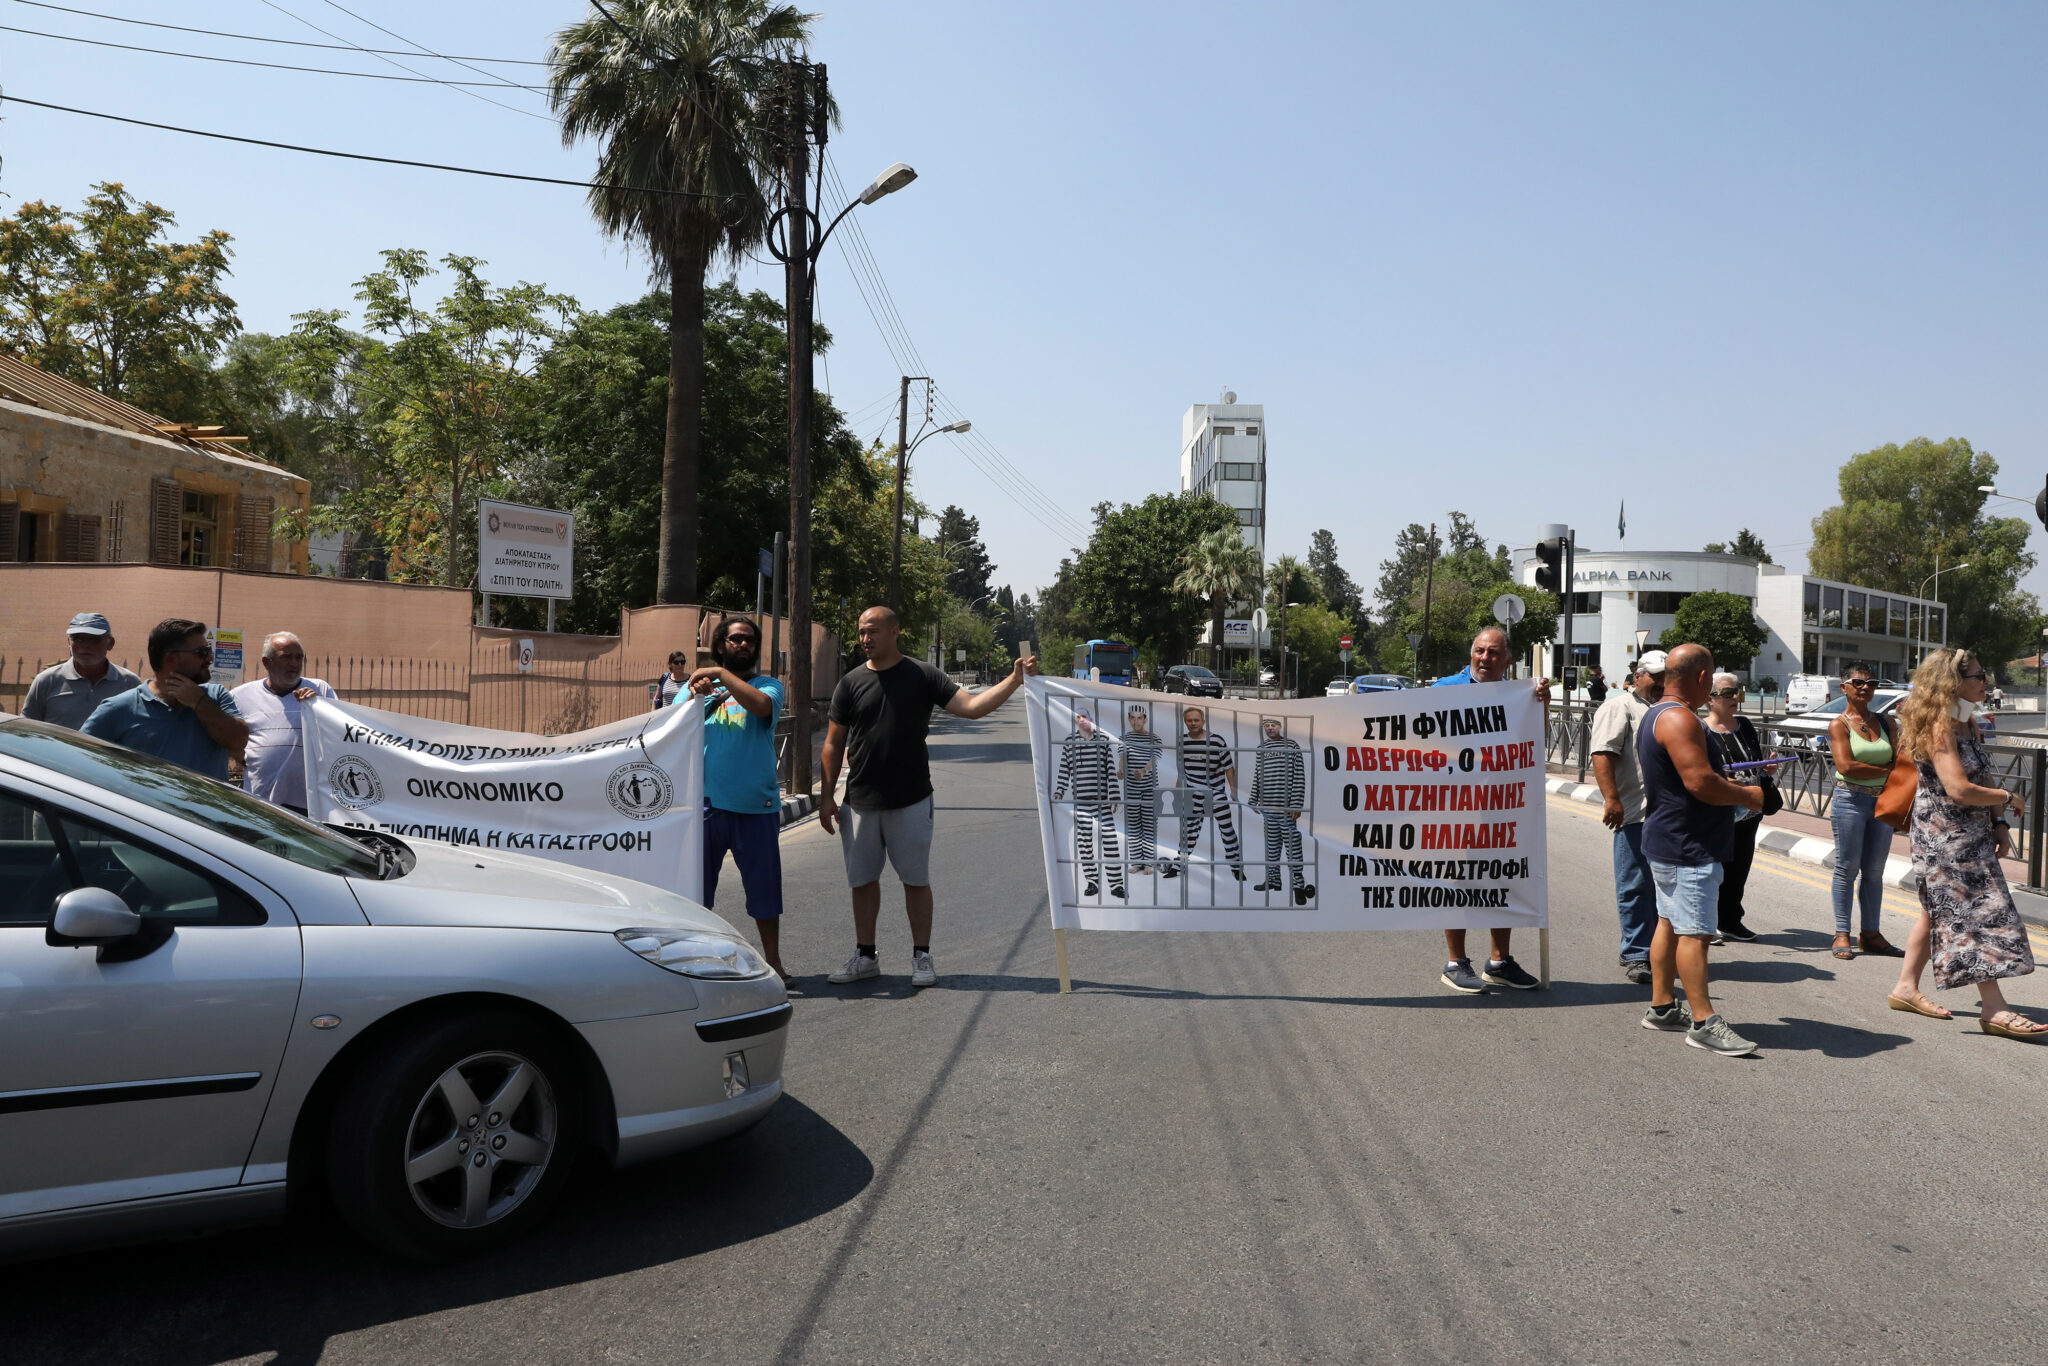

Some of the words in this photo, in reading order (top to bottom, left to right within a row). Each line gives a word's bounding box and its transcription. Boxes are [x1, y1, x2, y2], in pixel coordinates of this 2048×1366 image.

[495, 558, 536, 568] ΔΙΑΤΗΡΗΤΕΟΥ
[537, 562, 560, 571] ΚΤΙΡΙΟΥ
[505, 548, 552, 560] ΑΠΟΚΑΤΑΣΤΑΣΗ
[516, 577, 531, 587] ΤΟΥ
[1573, 570, 1619, 580] ALPHA
[1628, 570, 1672, 580] BANK
[1224, 623, 1248, 631] ACE
[1363, 714, 1406, 741] ΣΤΗ
[1412, 705, 1508, 739] ΦΥΛΑΚΗ
[1324, 745, 1340, 771] Ο
[1346, 746, 1453, 775] ΑΒΕΡΩΦ,
[1458, 748, 1475, 773] Ο
[1480, 741, 1536, 772] ΧΑΡΗΣ
[406, 778, 564, 802] ΟΙΚΟΝΟΜΙΚΟ
[1343, 783, 1359, 811] Ο
[1364, 782, 1526, 811] ΧΑΤΖΗΓΙΑΝΝΗΣ
[344, 822, 480, 847] ΞΙΚΟΠΗΜΑ
[487, 830, 502, 848] Η
[506, 831, 652, 852] ΚΑΤΑΣΤΡΟΦΗ
[1352, 824, 1393, 849] ΚΑΙ
[1399, 823, 1415, 850] Ο
[1421, 822, 1517, 850] ΗΛΙΑΔΗΣ
[1339, 855, 1368, 876] ΓΙΑ
[1369, 858, 1407, 877] ΤΗΝ
[1408, 856, 1529, 880] ΚΑΤΑΣΤΡΟΦΗ
[1361, 886, 1395, 908] ΤΗΣ
[1399, 886, 1510, 908] ΟΙΚΟΝΟΜΙΑΣ
